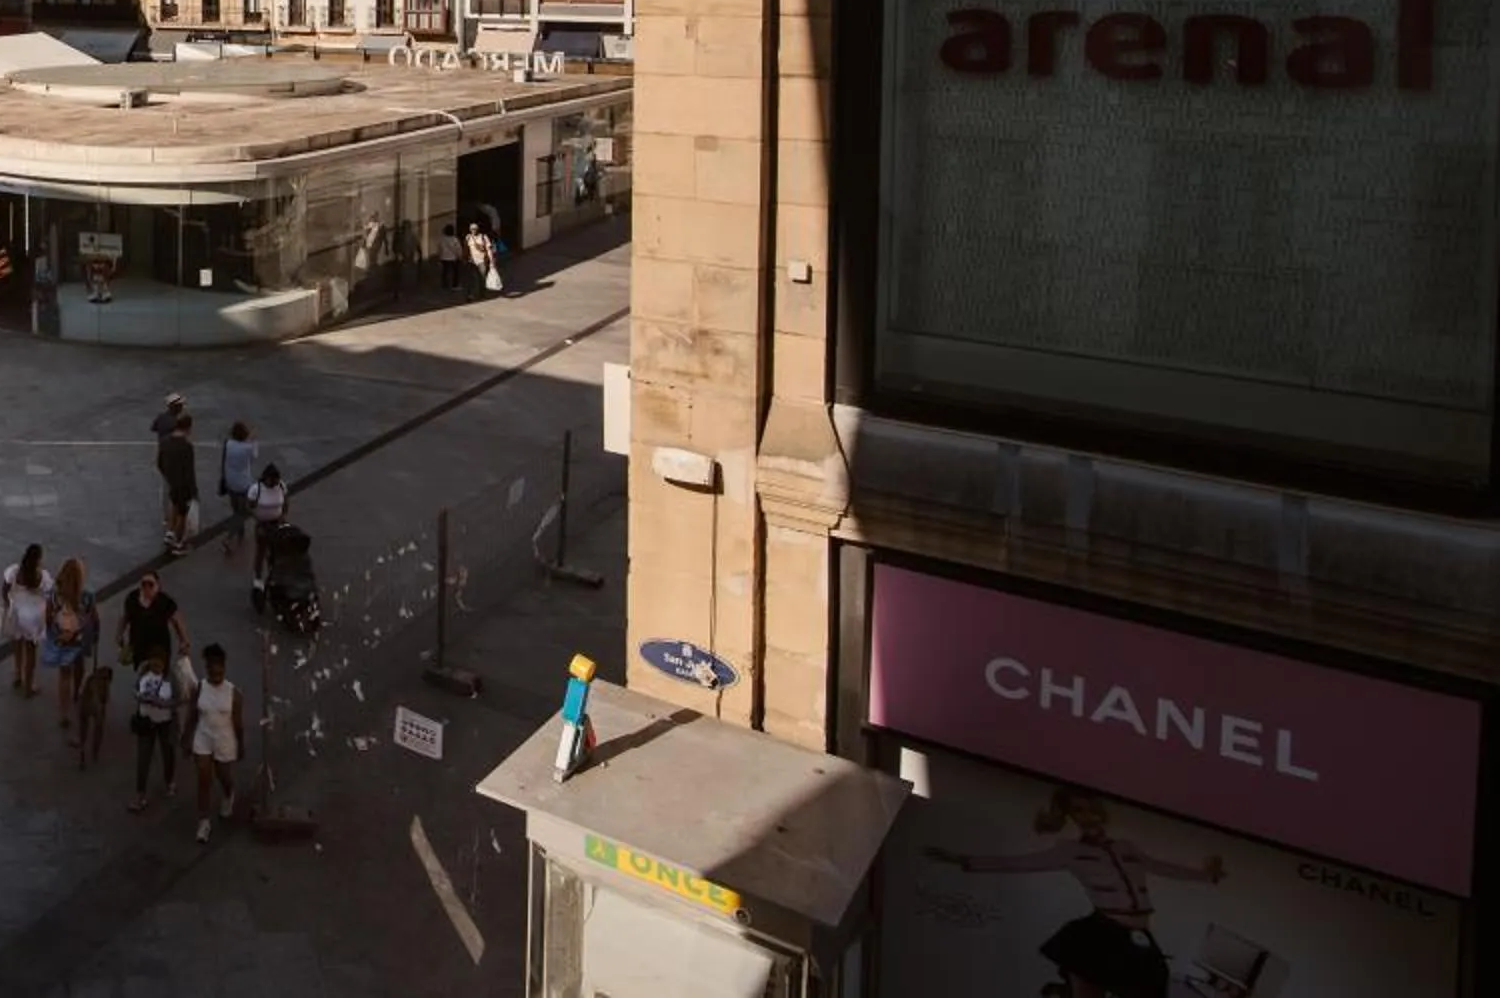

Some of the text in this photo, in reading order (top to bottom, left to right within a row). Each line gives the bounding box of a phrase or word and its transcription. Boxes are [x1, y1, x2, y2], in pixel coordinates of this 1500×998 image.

[984, 656, 1319, 781] CHANEL
[629, 850, 729, 907] ONCE
[1298, 862, 1438, 918] CHANEL
